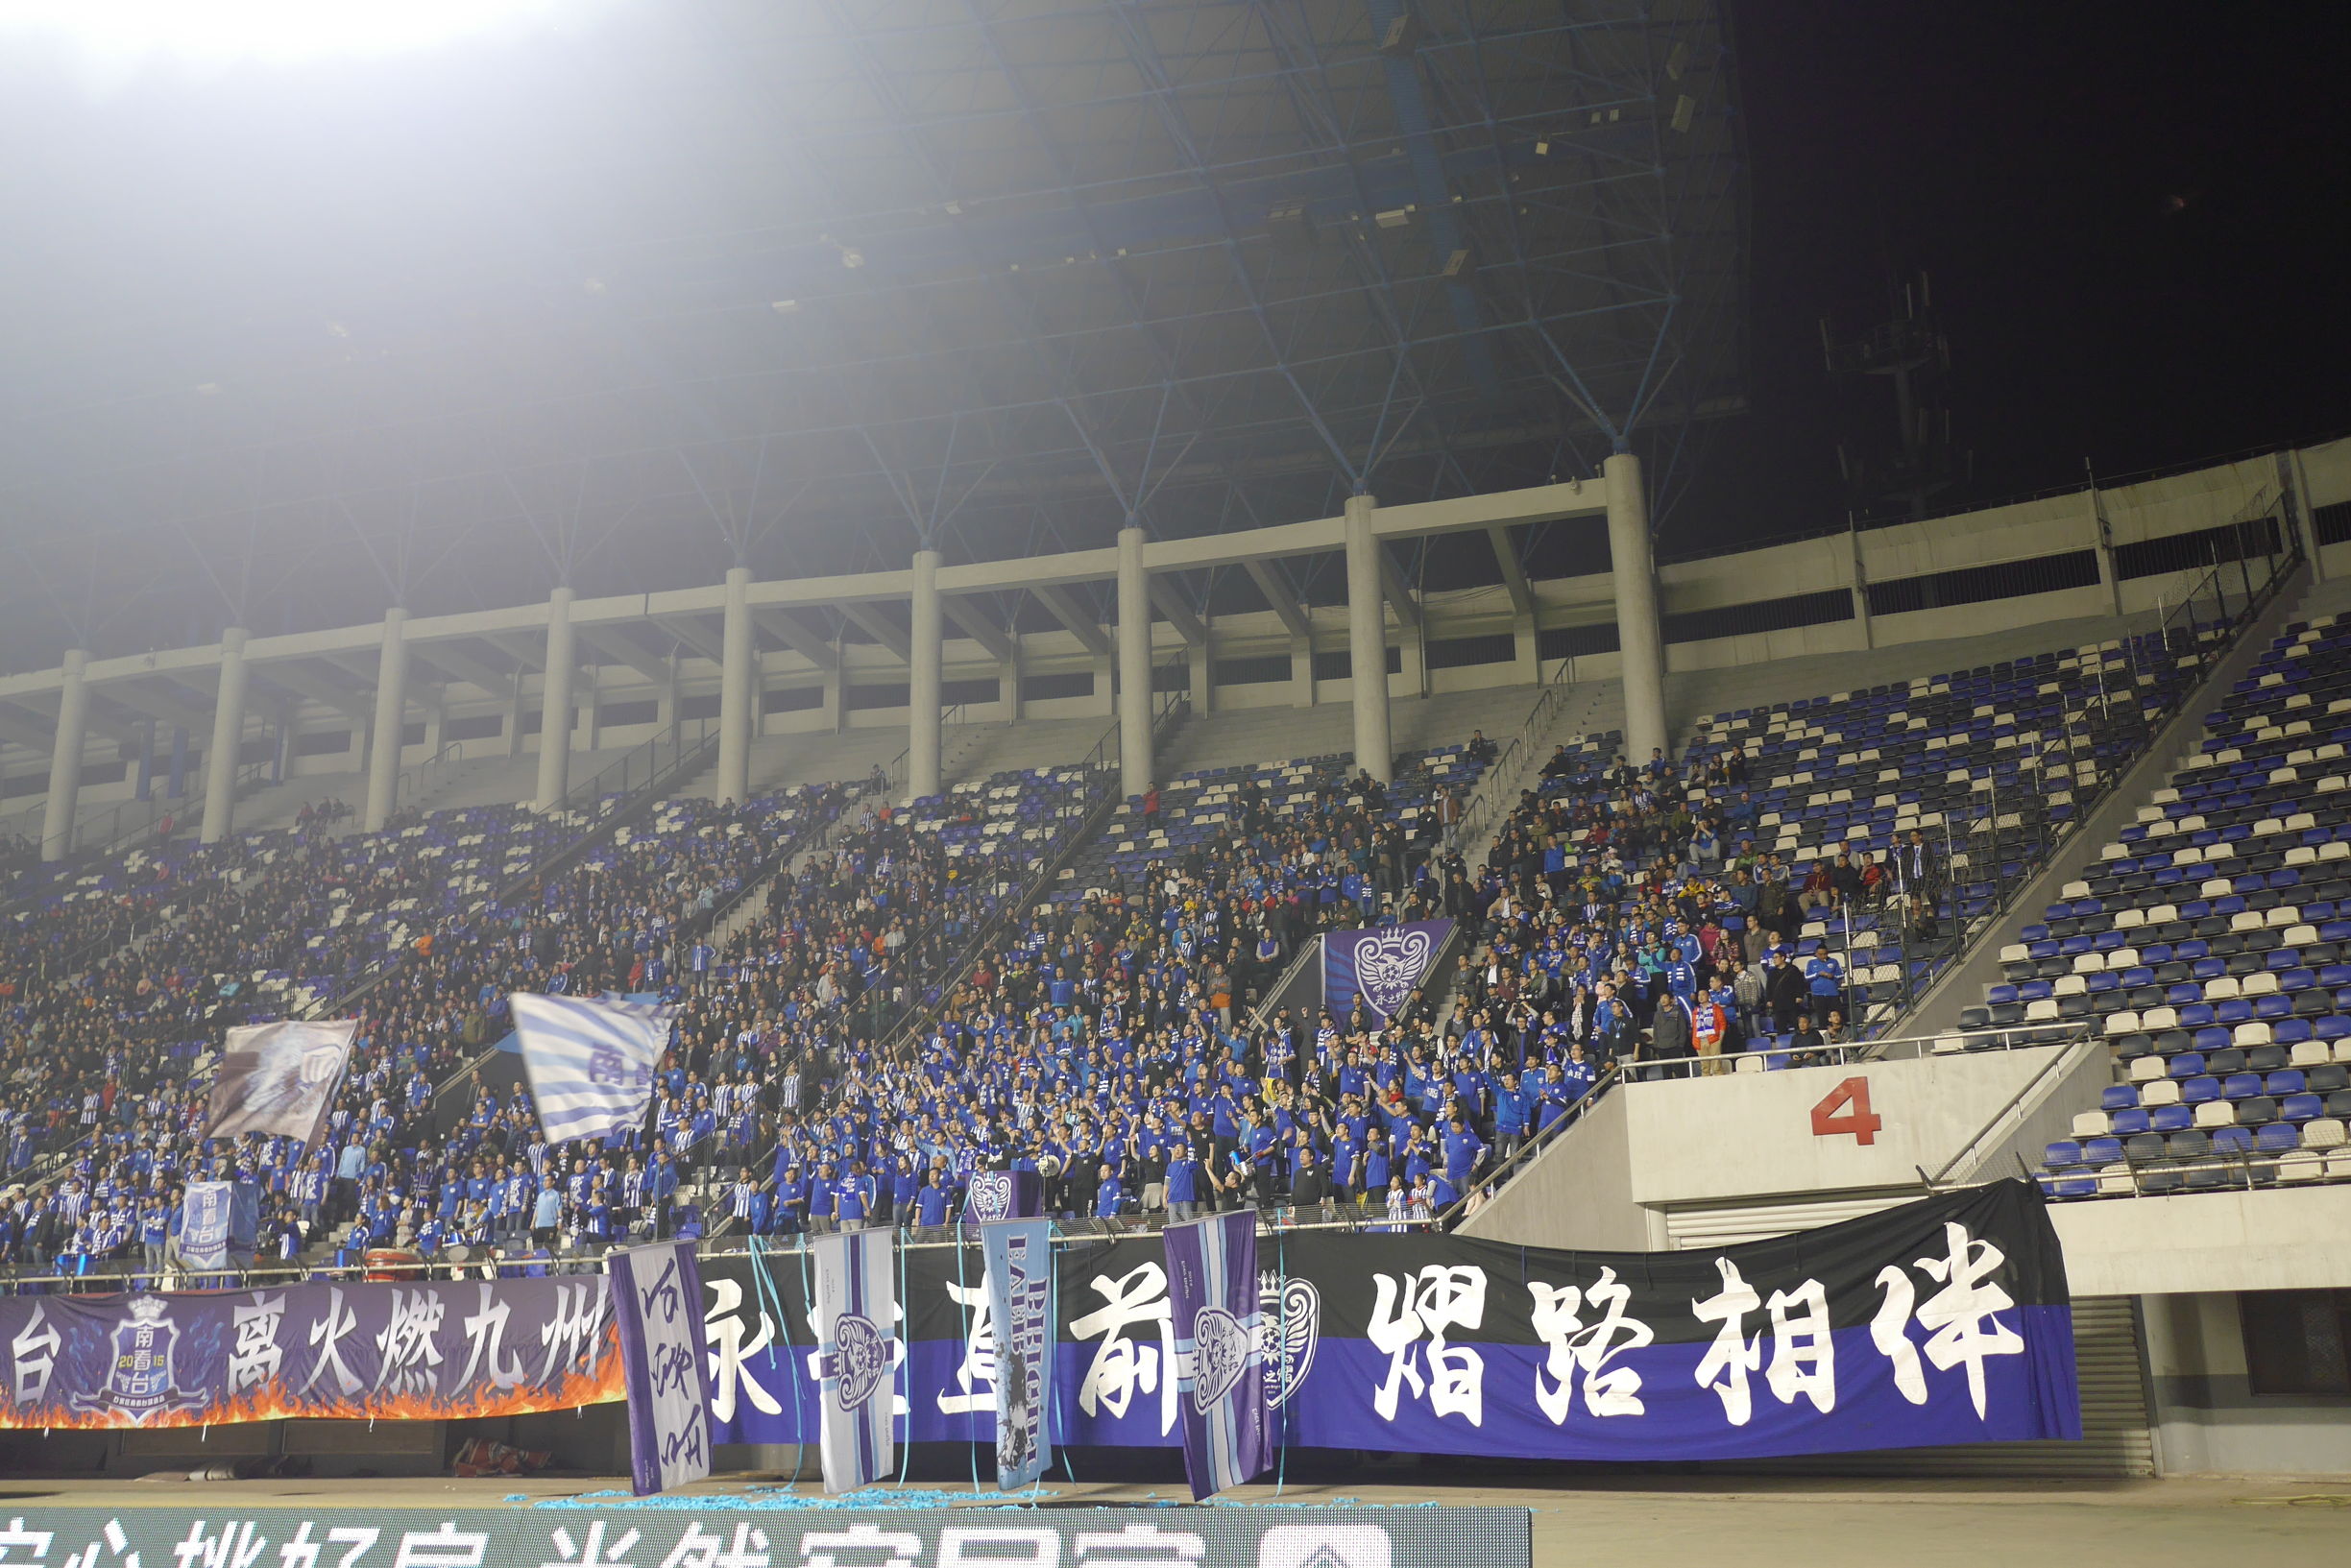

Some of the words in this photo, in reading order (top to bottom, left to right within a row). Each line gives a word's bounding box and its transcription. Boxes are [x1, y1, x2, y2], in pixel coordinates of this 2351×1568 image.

[1810, 1076, 1881, 1146] 4
[12, 1301, 61, 1407] 台
[131, 1325, 154, 1394] 南看台
[228, 1275, 612, 1396] 离火燃九州
[1367, 1221, 2024, 1428] 熠路相伴
